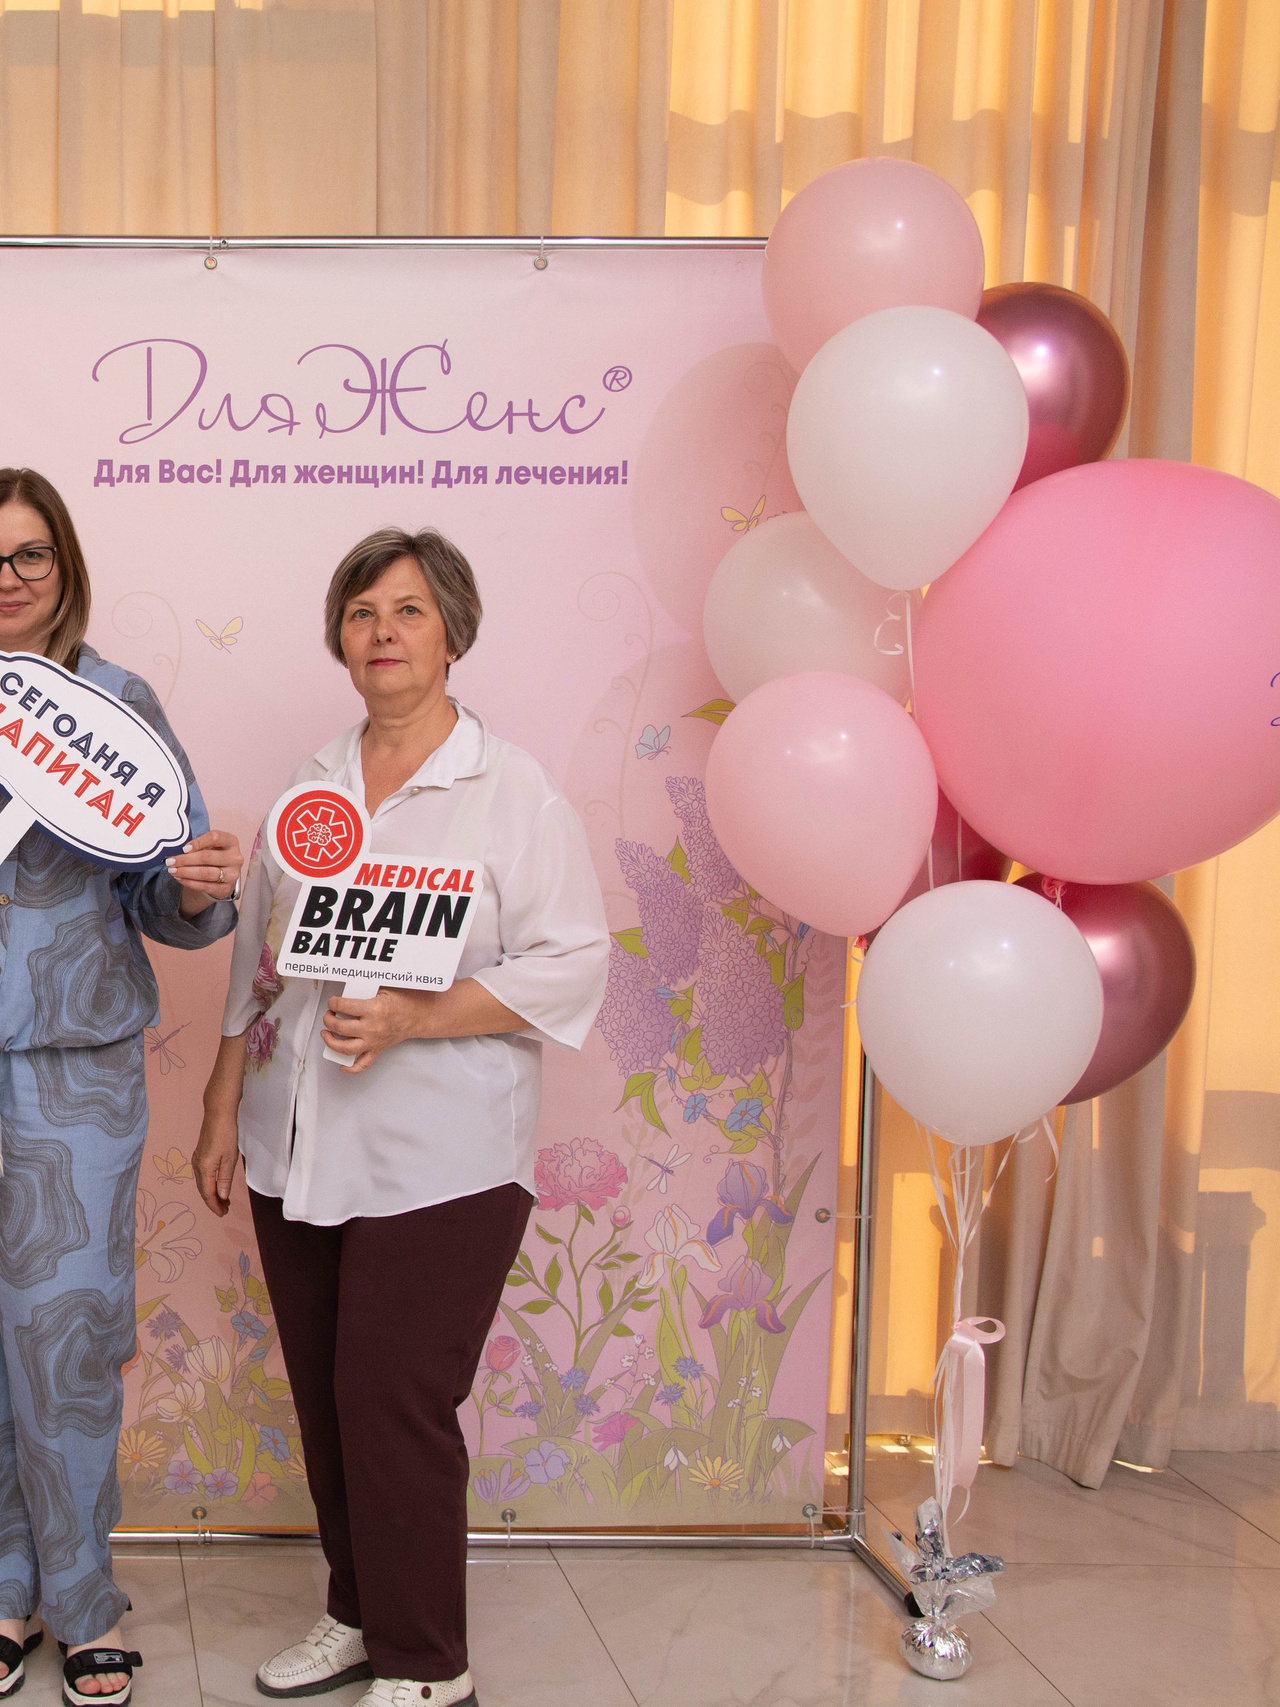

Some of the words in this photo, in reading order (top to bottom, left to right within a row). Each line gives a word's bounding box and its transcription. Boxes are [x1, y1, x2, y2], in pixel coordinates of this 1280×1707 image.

[93, 459, 150, 489] Для
[158, 459, 222, 485] Вас!
[229, 459, 286, 489] Для
[293, 459, 423, 490] женщин!
[430, 460, 487, 489] Для
[494, 460, 628, 487] лечения!
[0, 672, 138, 787] СЕГОДНЯ
[137, 781, 166, 808] Я
[352, 862, 475, 893] MEDICAL
[298, 885, 472, 939] BRAIN
[290, 930, 399, 963] BATTLE
[284, 962, 330, 975] первый
[331, 966, 413, 983] медицинский
[415, 975, 444, 986] квиз
